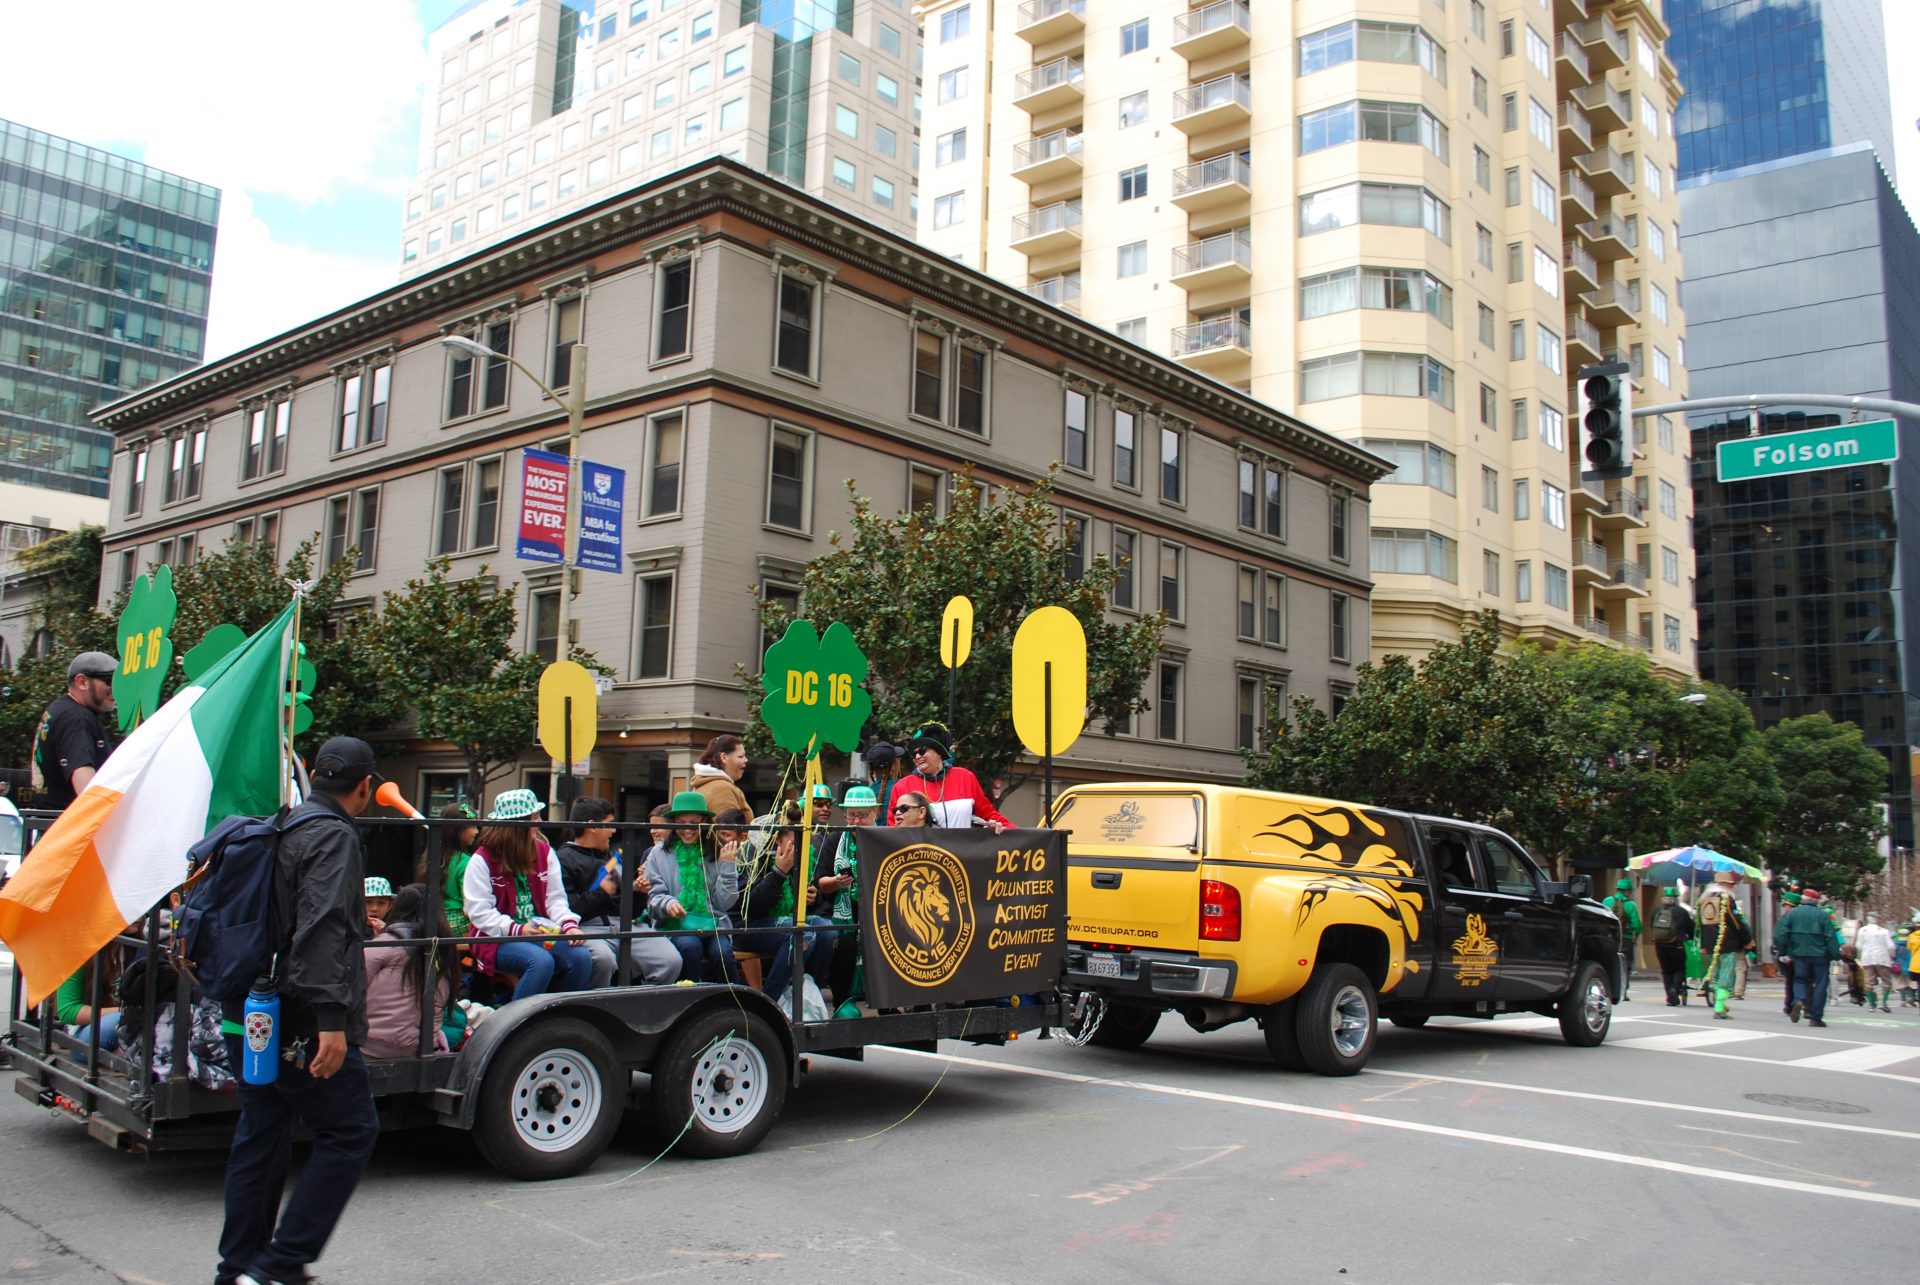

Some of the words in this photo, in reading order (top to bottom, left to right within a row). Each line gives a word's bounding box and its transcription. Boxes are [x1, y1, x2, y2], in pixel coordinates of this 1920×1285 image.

[1754, 439, 1859, 467] Folsom
[526, 474, 566, 493] MOST
[582, 491, 621, 509] Wharton
[523, 510, 565, 529] EVER.
[585, 516, 604, 530] MBA
[605, 520, 617, 532] for
[580, 528, 620, 545] Executives
[122, 632, 143, 675] DC
[145, 626, 162, 669] 16
[786, 670, 818, 705] DC
[828, 673, 852, 707] 16
[996, 849, 1020, 873] DC
[1023, 849, 1046, 872] 16
[878, 856, 906, 905] VOLUNTEER
[906, 850, 943, 862] ACTIVIST
[942, 857, 967, 905] COMMITTEE
[986, 880, 1054, 901] VOLUNTEER
[995, 904, 1048, 924] ACTIVIST
[880, 924, 893, 950] HIGH
[956, 922, 971, 952] VALUE
[988, 928, 1055, 950] COMMITTEE
[1068, 924, 1159, 938] WW.DC16IUPAT.ORG
[905, 943, 929, 963] DC
[931, 941, 947, 960] 16
[1004, 953, 1042, 973] EVENT
[1089, 962, 1119, 975] 8X69393
